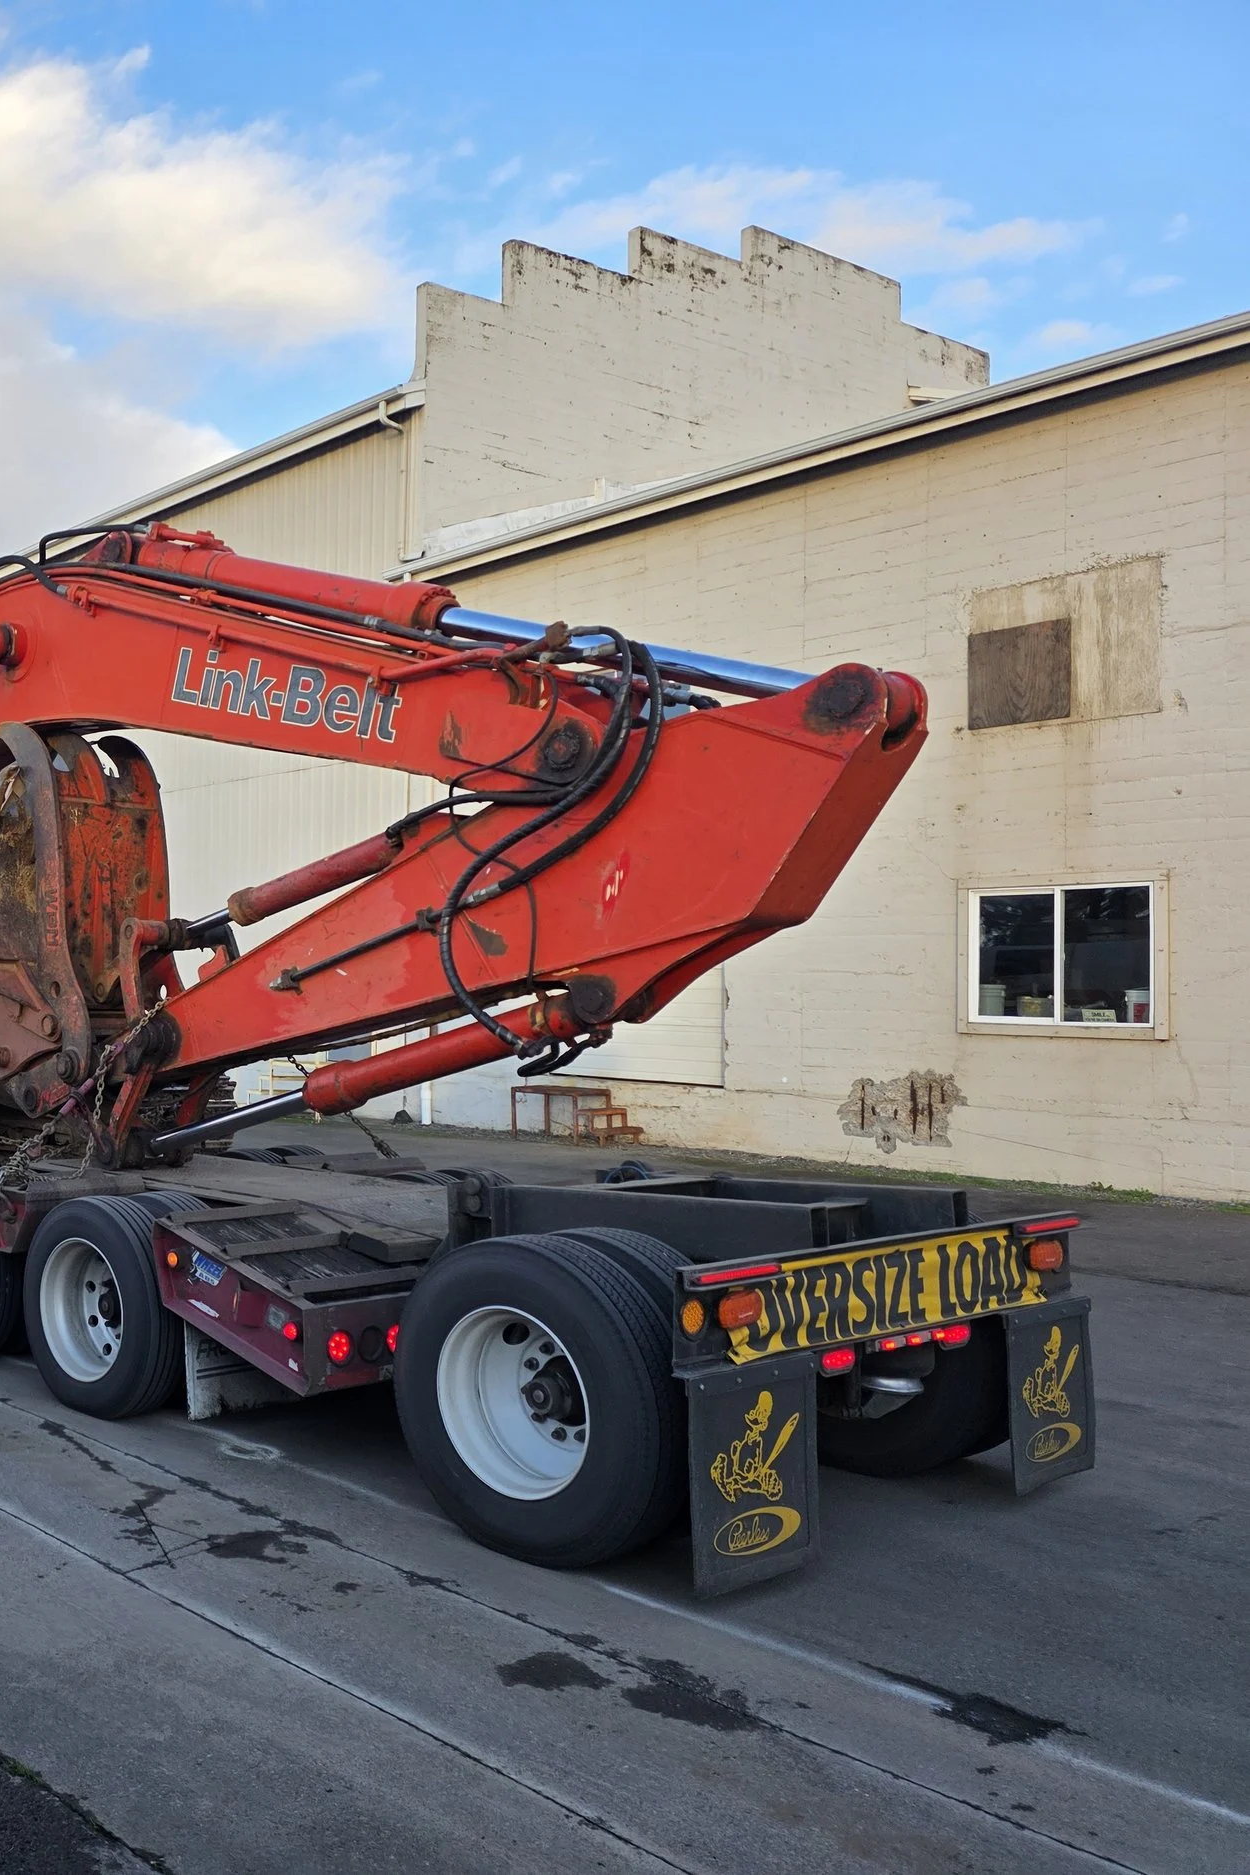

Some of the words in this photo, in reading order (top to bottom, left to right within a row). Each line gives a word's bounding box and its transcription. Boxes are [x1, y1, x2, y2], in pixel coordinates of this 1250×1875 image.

[171, 647, 402, 743] Link-Belt
[748, 1249, 928, 1352] OVERSIZE
[936, 1235, 1030, 1318] LOAD
